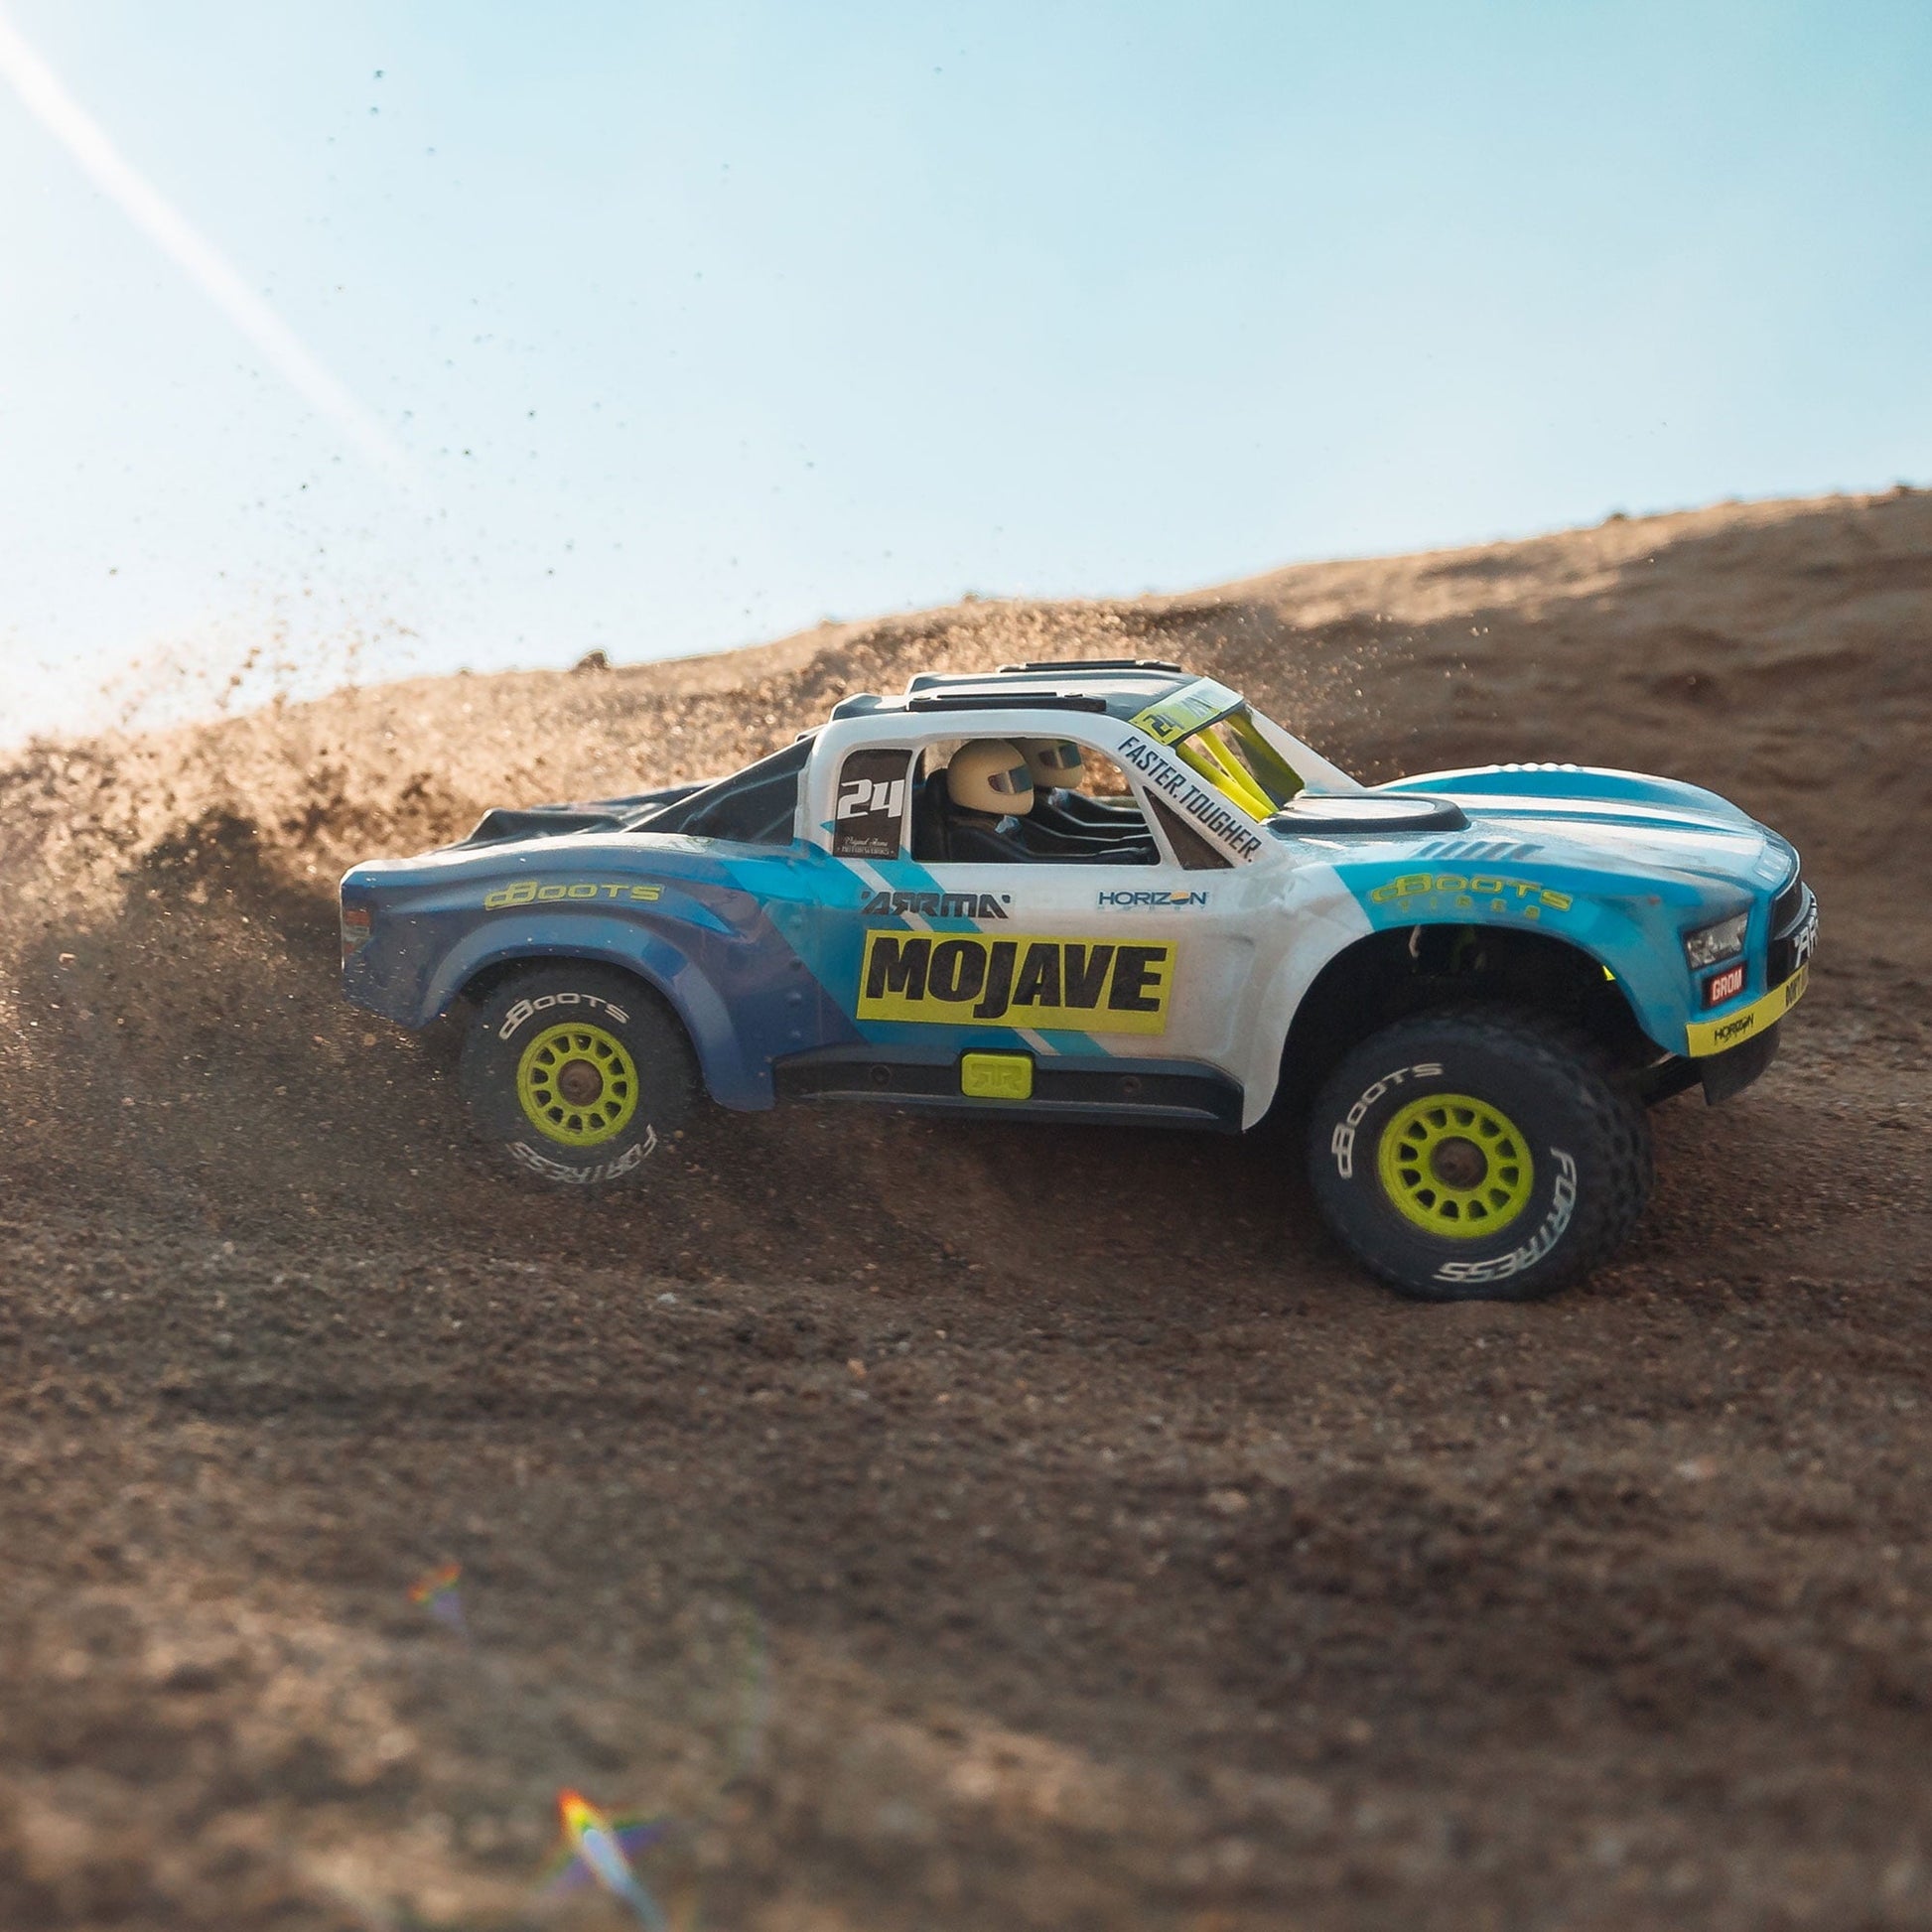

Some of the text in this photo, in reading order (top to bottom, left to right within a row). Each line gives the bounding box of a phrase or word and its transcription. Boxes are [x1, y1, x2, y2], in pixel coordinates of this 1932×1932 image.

[836, 778, 905, 820] 24
[1098, 891, 1208, 905] HORIZON
[866, 936, 1169, 1020] MOJAVE
